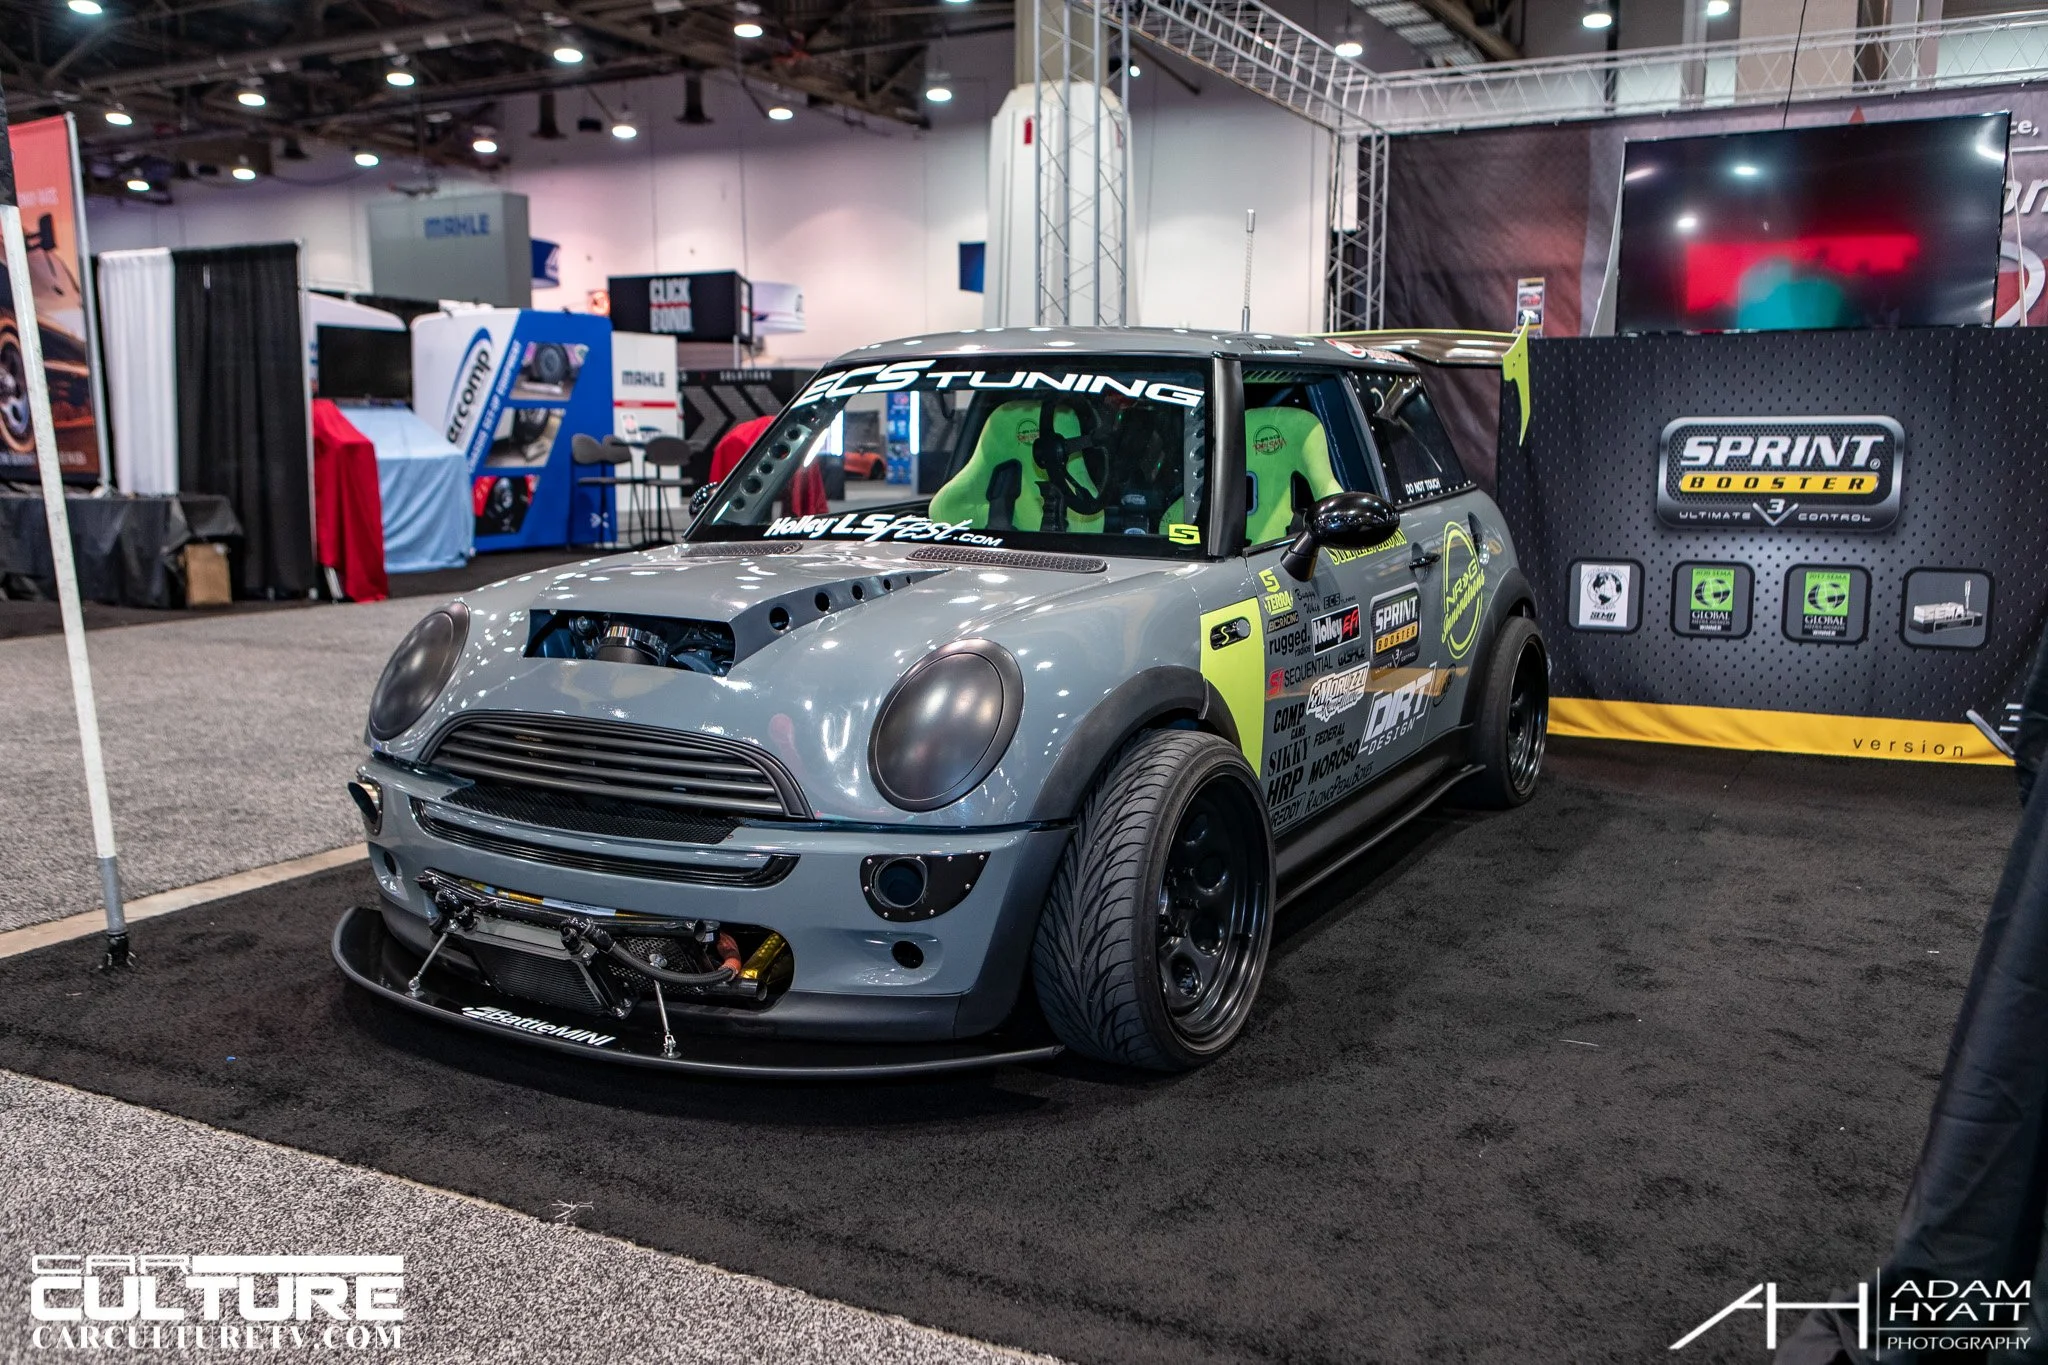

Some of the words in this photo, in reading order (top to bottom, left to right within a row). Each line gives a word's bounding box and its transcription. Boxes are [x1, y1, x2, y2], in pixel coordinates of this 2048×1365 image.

[424, 214, 489, 238] MAHLE
[650, 278, 690, 302] CLICK
[622, 370, 665, 387] MAHLE
[927, 372, 1205, 407] TUNING
[1680, 435, 1884, 467] SPRINT
[1405, 483, 1415, 496] DO
[1414, 480, 1425, 493] NOT
[1424, 477, 1441, 491] TOUCH
[1689, 476, 1865, 491] BOOSTER
[763, 515, 838, 538] Holley
[1679, 511, 1751, 520] ULTIMATE
[1798, 512, 1871, 522] CONTROL
[1375, 595, 1418, 634] SPRINT
[1590, 611, 1616, 620] SEMA
[1692, 611, 1730, 620] GLOBAL
[1804, 615, 1844, 625] GLOBAL
[1313, 616, 1343, 644] Holley
[1377, 625, 1416, 650] BOOSTER
[1284, 654, 1333, 688] SEQUENTIAL
[1273, 702, 1306, 734] COMP
[1313, 721, 1345, 748] FEDERAL
[1368, 717, 1415, 756] DESIGN
[1852, 737, 1964, 758] version
[1268, 735, 1311, 777] SIKKY
[1308, 738, 1360, 786] MOROSO
[1267, 765, 1304, 808] HRP
[487, 1008, 616, 1046] BattleMINI
